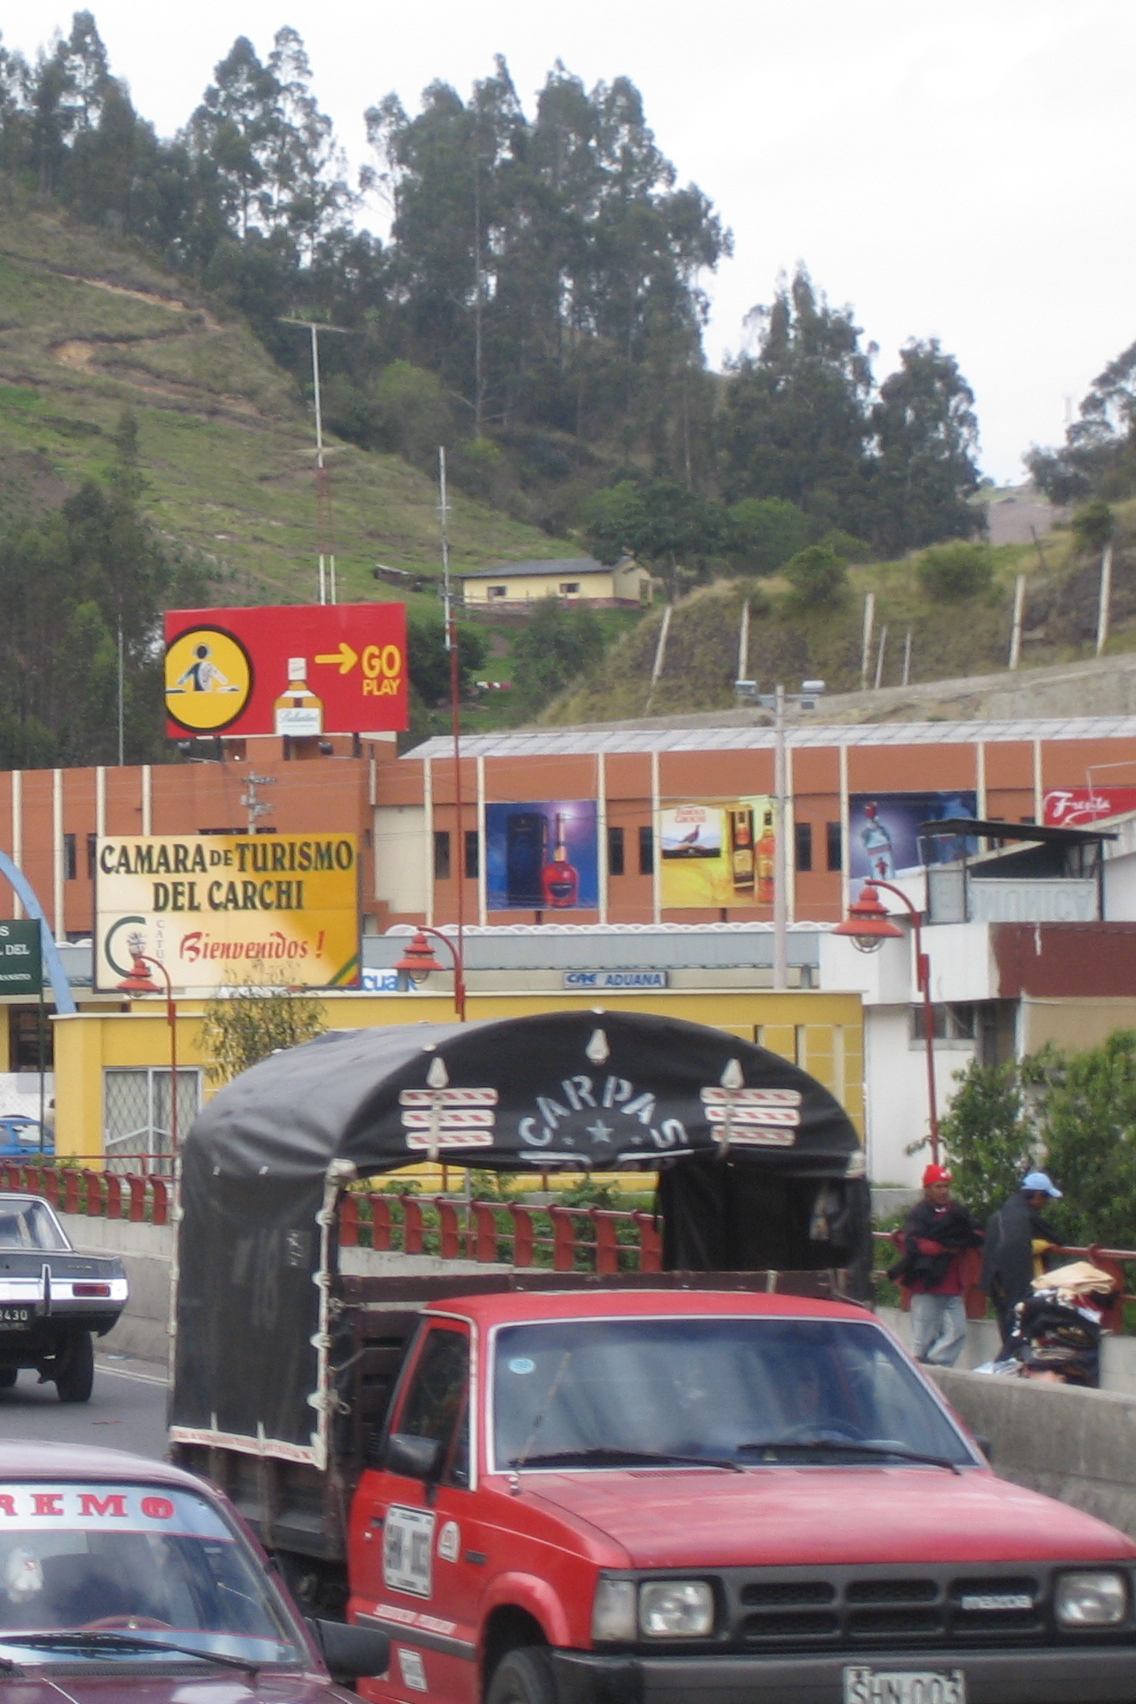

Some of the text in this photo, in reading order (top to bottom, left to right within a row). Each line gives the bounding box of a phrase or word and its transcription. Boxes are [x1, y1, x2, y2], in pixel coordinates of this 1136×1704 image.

[362, 645, 401, 678] GO
[363, 679, 401, 696] PLAY
[100, 840, 354, 874] CAMARA DE TURISMO
[152, 880, 305, 912] DEL CARCHI
[5, 943, 30, 955] DEL
[605, 974, 662, 986] ADUANA
[518, 1075, 689, 1148] CARPAS
